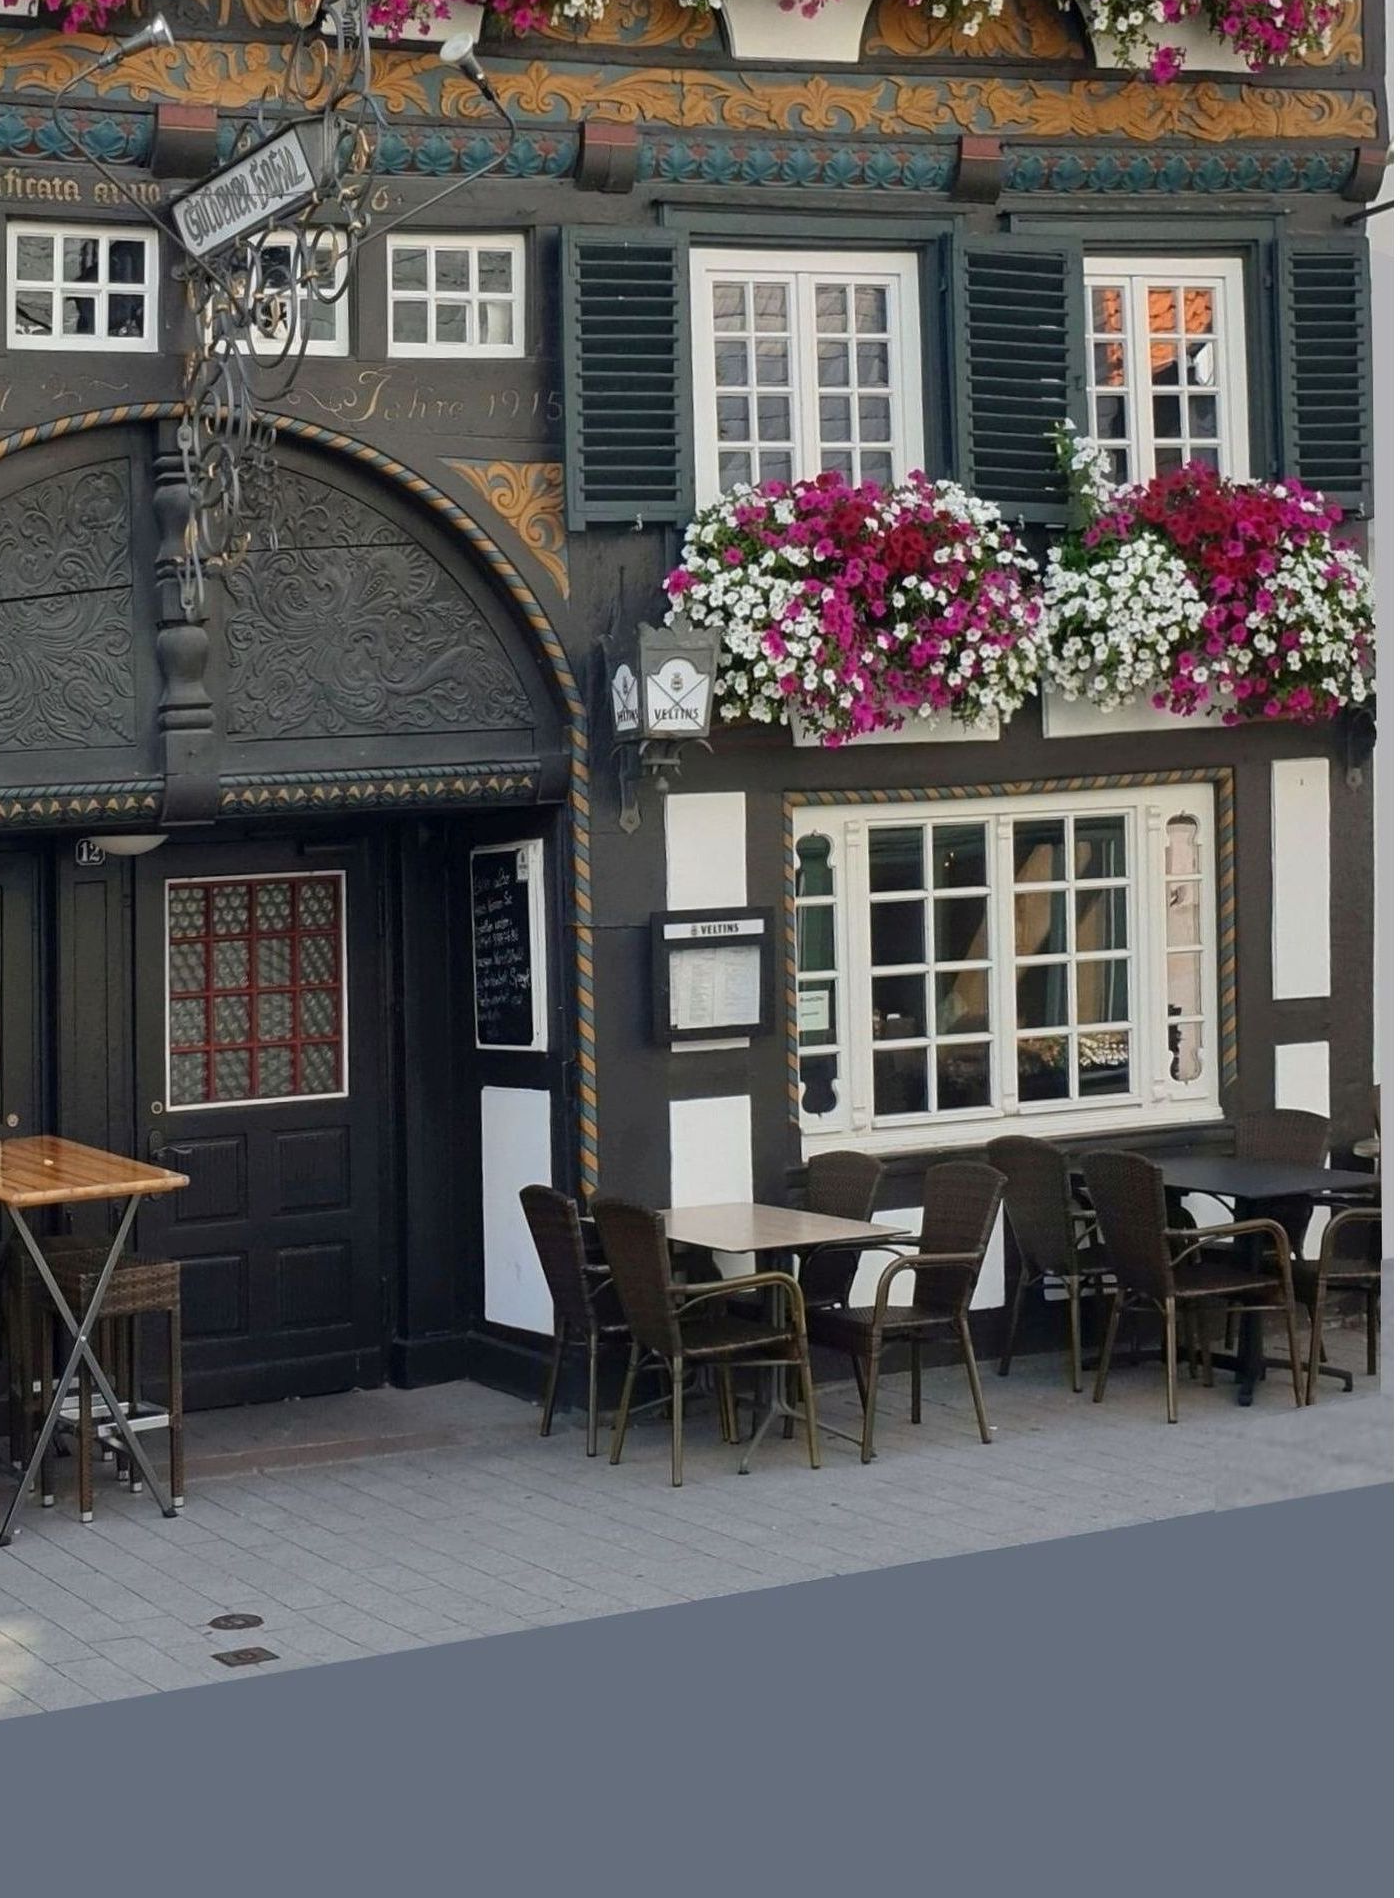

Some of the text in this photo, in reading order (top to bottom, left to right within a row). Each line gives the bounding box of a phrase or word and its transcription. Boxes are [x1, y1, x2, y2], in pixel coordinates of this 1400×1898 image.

[654, 707, 699, 720] VELTINS
[80, 842, 100, 862] 12
[700, 923, 739, 935] VELTINS
